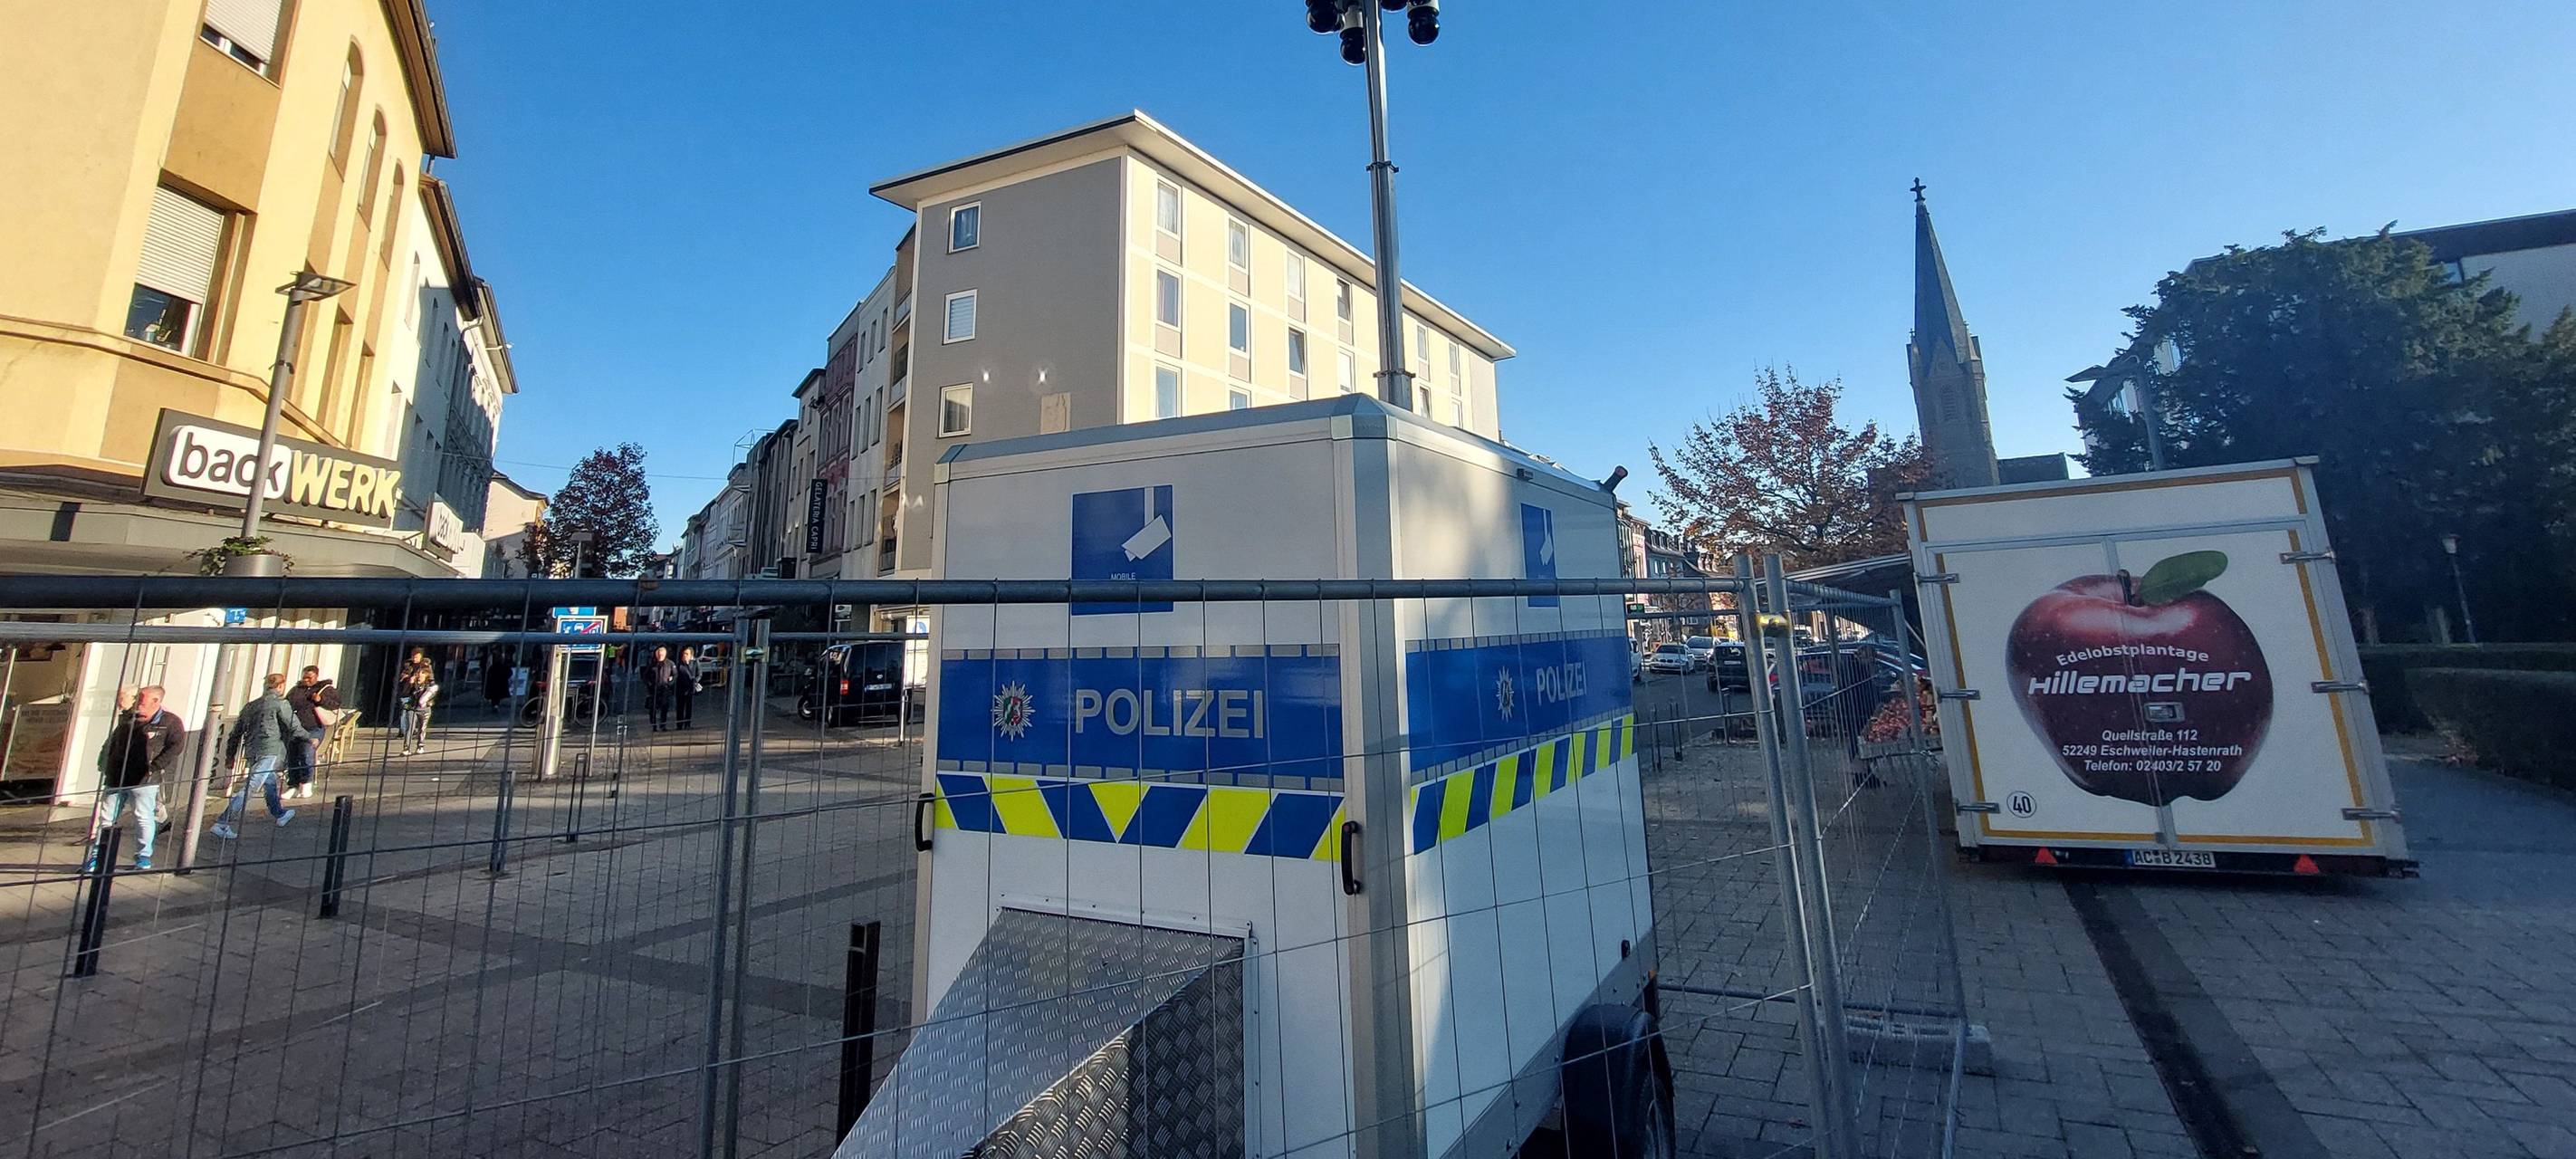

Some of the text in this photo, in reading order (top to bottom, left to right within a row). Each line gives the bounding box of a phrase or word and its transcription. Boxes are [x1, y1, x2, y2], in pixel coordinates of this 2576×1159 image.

[810, 482, 823, 550] GELATERIA CAPRI
[1110, 572, 1136, 580] MOBILE
[2055, 644, 2209, 666] Edelobstplantage
[1536, 660, 1587, 706] POLIZEI
[2027, 667, 2252, 694] Hillemacher
[1075, 688, 1264, 739] POLIZEI
[2102, 730, 2198, 742] Quellstraße 112
[2062, 745, 2243, 757] 52249 Eschweiler-Hastenrath
[2084, 760, 2222, 772] Telefon: 02403/2 57 20
[2013, 796, 2032, 813] 40
[2173, 852, 2212, 866] 2438
